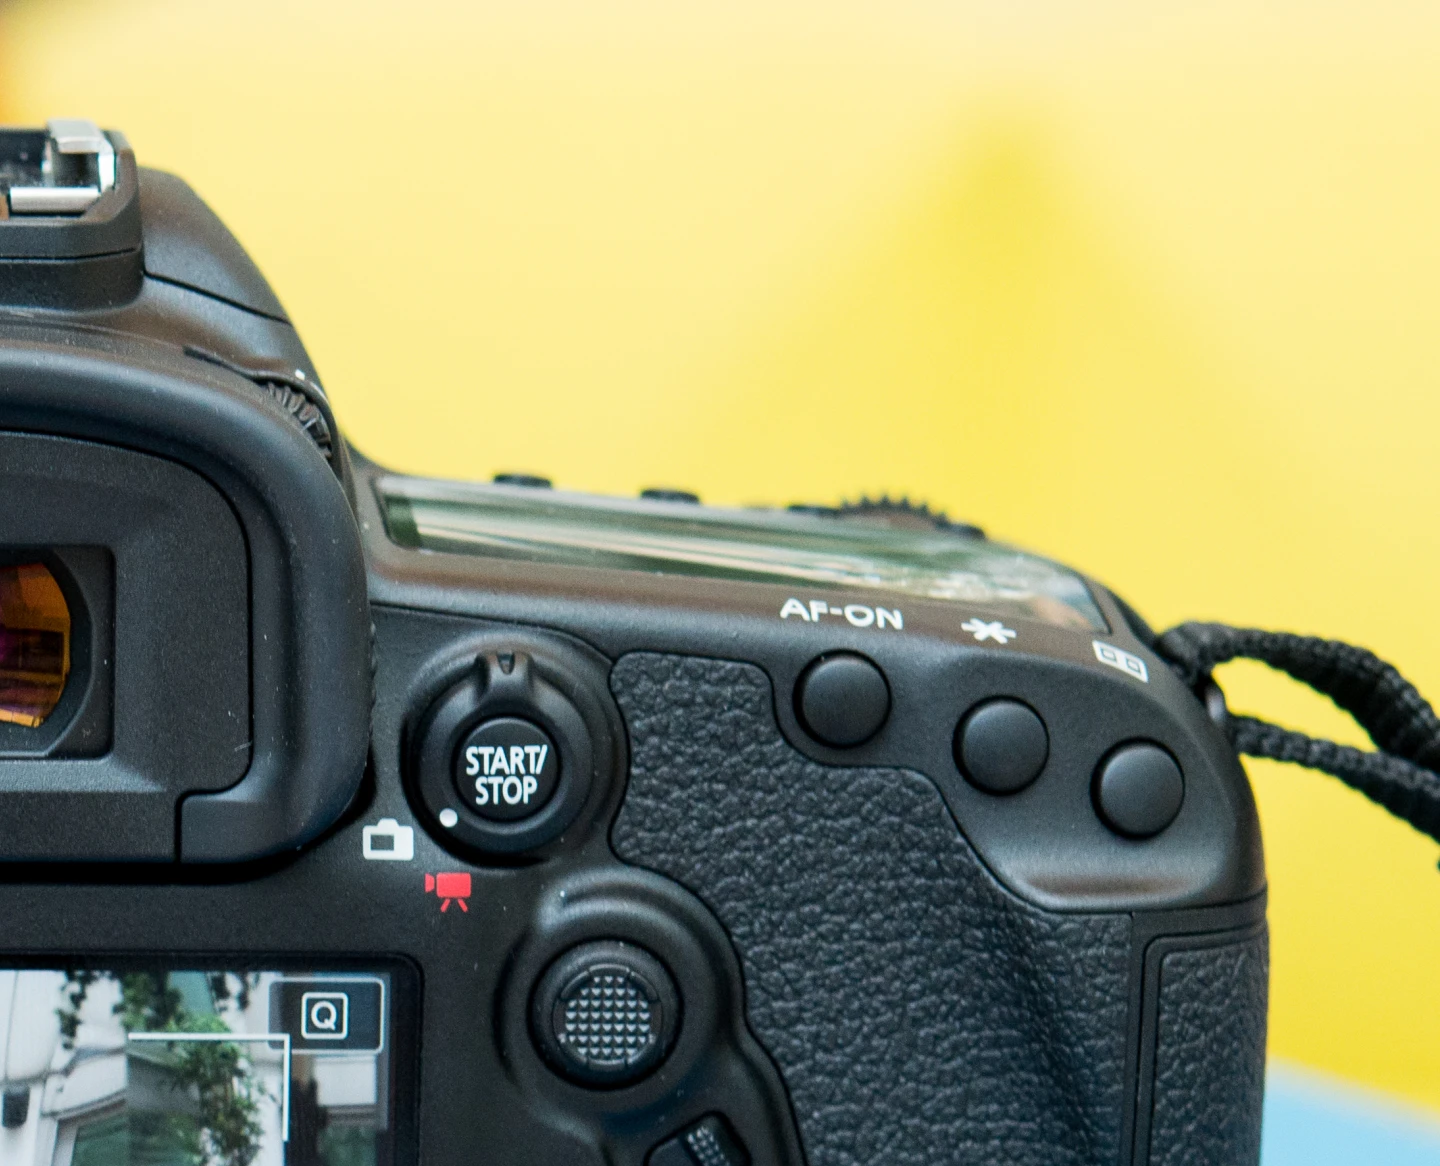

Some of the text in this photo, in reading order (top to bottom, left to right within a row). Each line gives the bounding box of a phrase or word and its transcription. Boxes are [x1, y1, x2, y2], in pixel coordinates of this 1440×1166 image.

[779, 597, 904, 630] AF-ON
[465, 744, 548, 775] START/
[475, 776, 538, 805] STOP
[310, 1000, 336, 1031] Q
